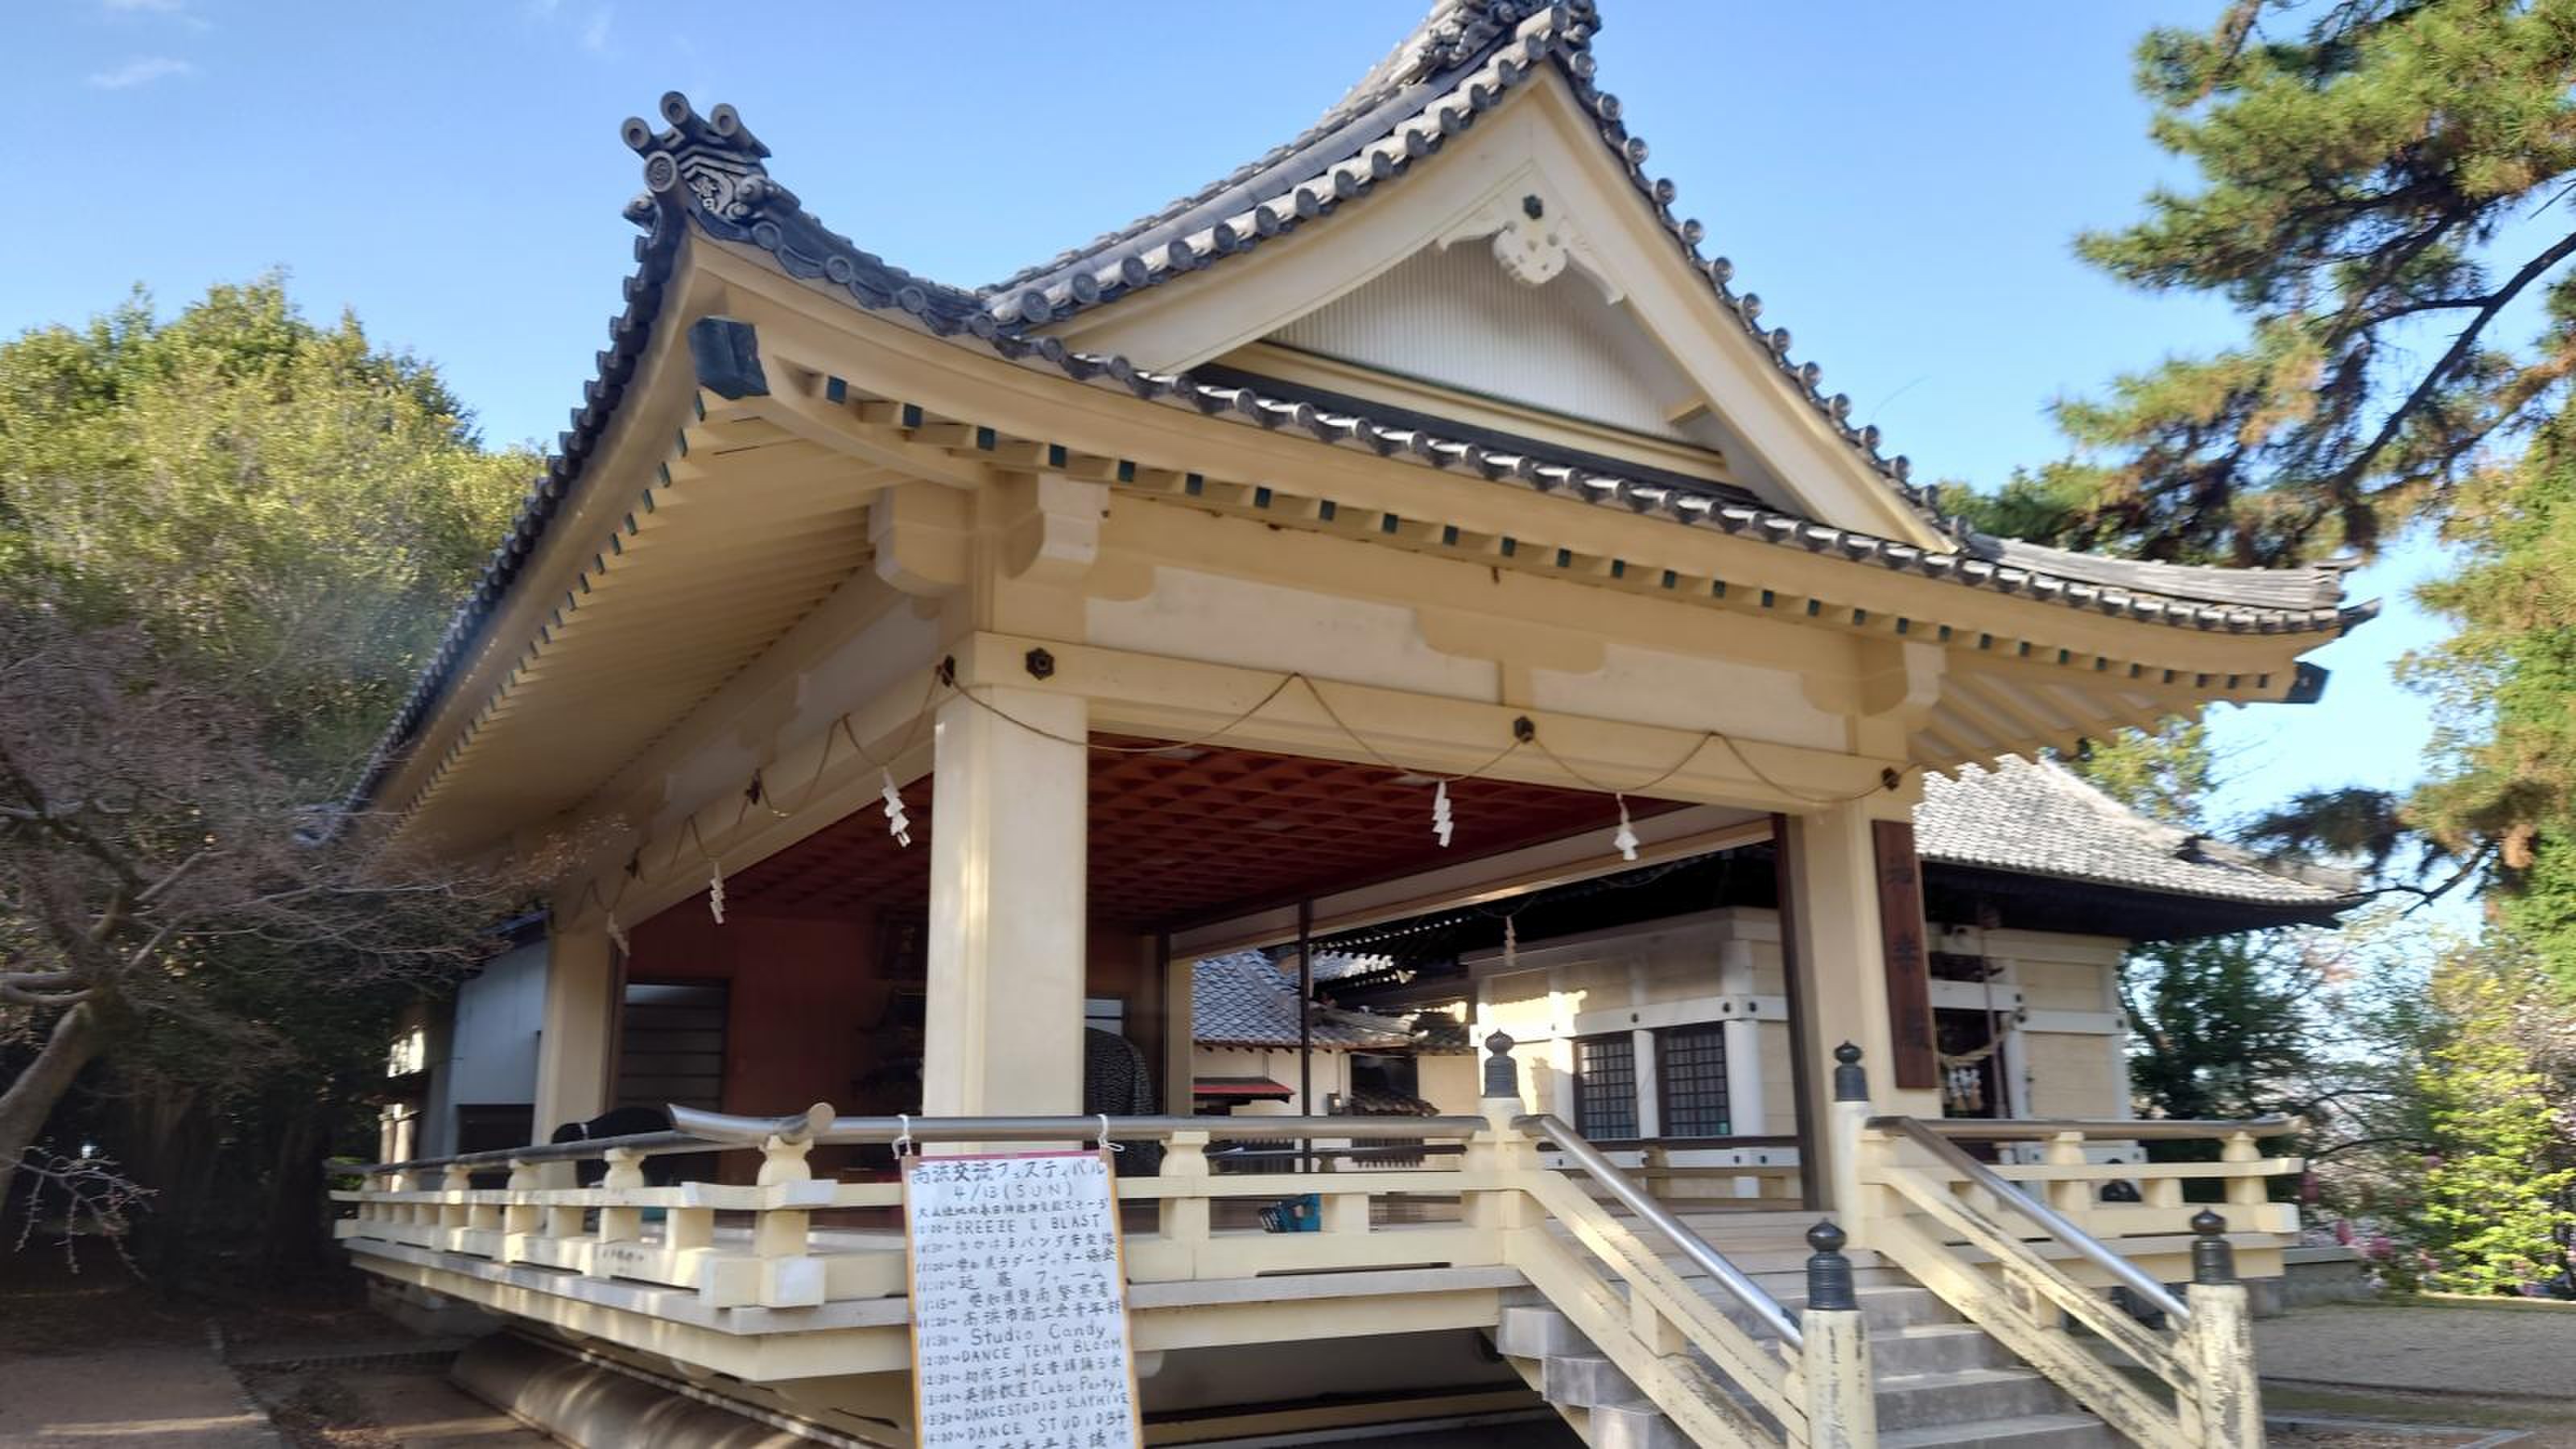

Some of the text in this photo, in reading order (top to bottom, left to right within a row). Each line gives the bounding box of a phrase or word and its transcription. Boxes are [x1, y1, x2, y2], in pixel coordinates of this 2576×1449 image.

[956, 1218, 1017, 1236] BREEZE
[1051, 1213, 1100, 1229] BLAST
[971, 1327, 1033, 1346] Studio
[1048, 1320, 1105, 1340] Candy
[961, 1347, 1011, 1363] DANCE
[1023, 1343, 1063, 1359] TEAM
[967, 1422, 1022, 1443] DANCE
